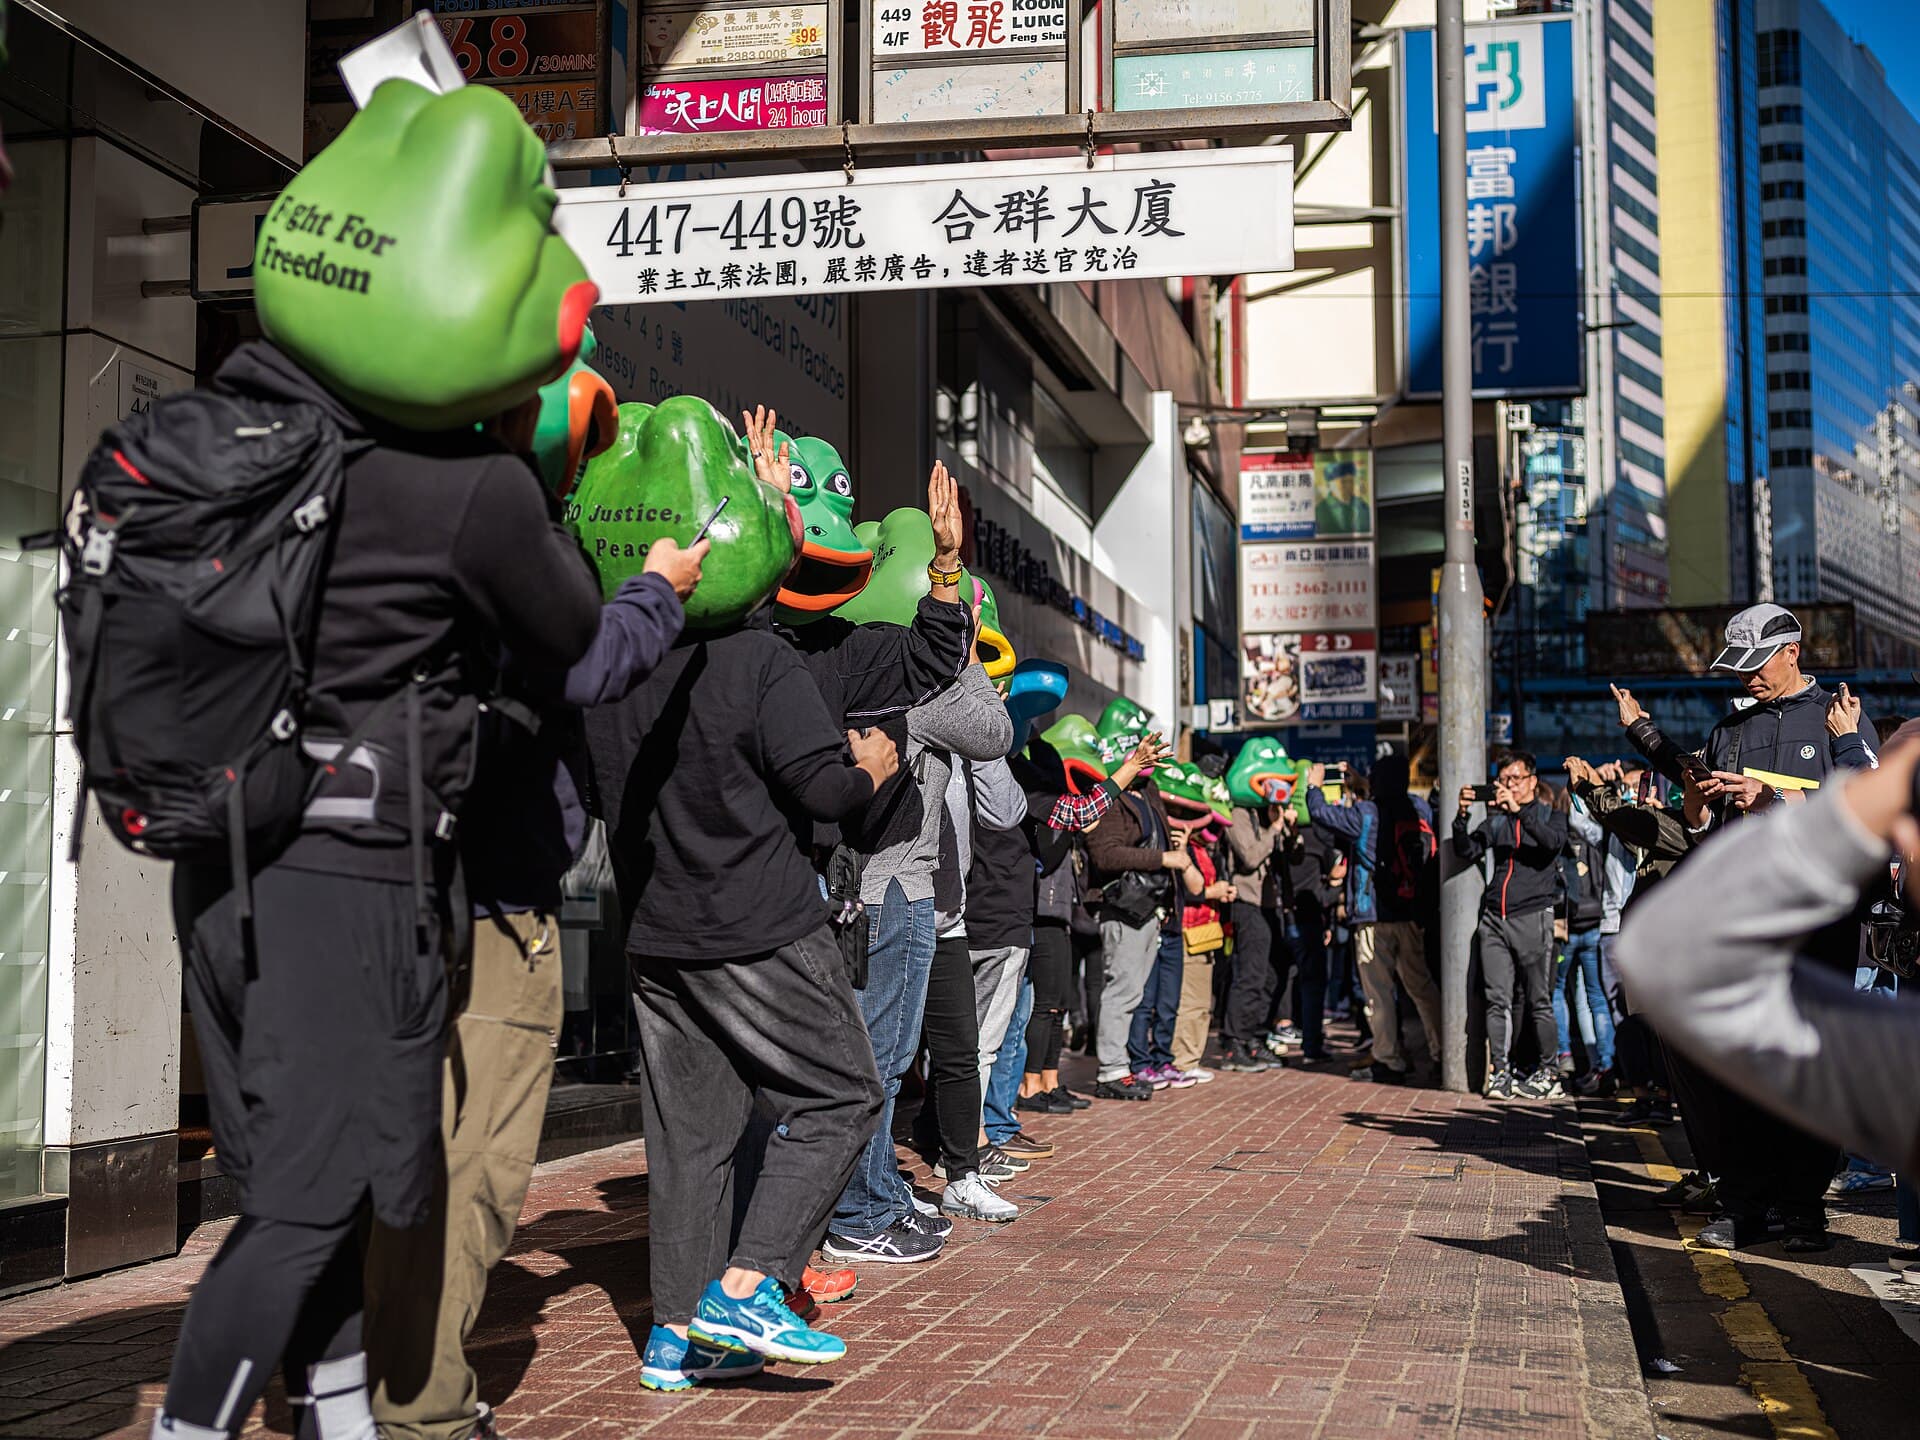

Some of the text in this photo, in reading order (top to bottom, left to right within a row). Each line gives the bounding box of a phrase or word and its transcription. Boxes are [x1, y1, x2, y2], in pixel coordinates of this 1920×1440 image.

[880, 8, 912, 23] 449
[1011, 13, 1065, 29] LUNG
[724, 24, 754, 33] ELEGANT
[755, 22, 782, 30] BEAUTY
[1010, 29, 1067, 44] Feng Shui
[882, 31, 909, 47] 4/F
[728, 51, 756, 62] 2383
[758, 48, 788, 60] 0008
[1206, 92, 1233, 104] 9156
[768, 105, 827, 128] 24 hour
[932, 178, 1186, 244] 合群大廈
[334, 213, 397, 257] For
[260, 235, 371, 295] Freedom
[1467, 145, 1520, 374] 富邦銀行
[790, 326, 846, 400] Practice
[588, 502, 683, 525] Justice,
[595, 537, 649, 558] Peac
